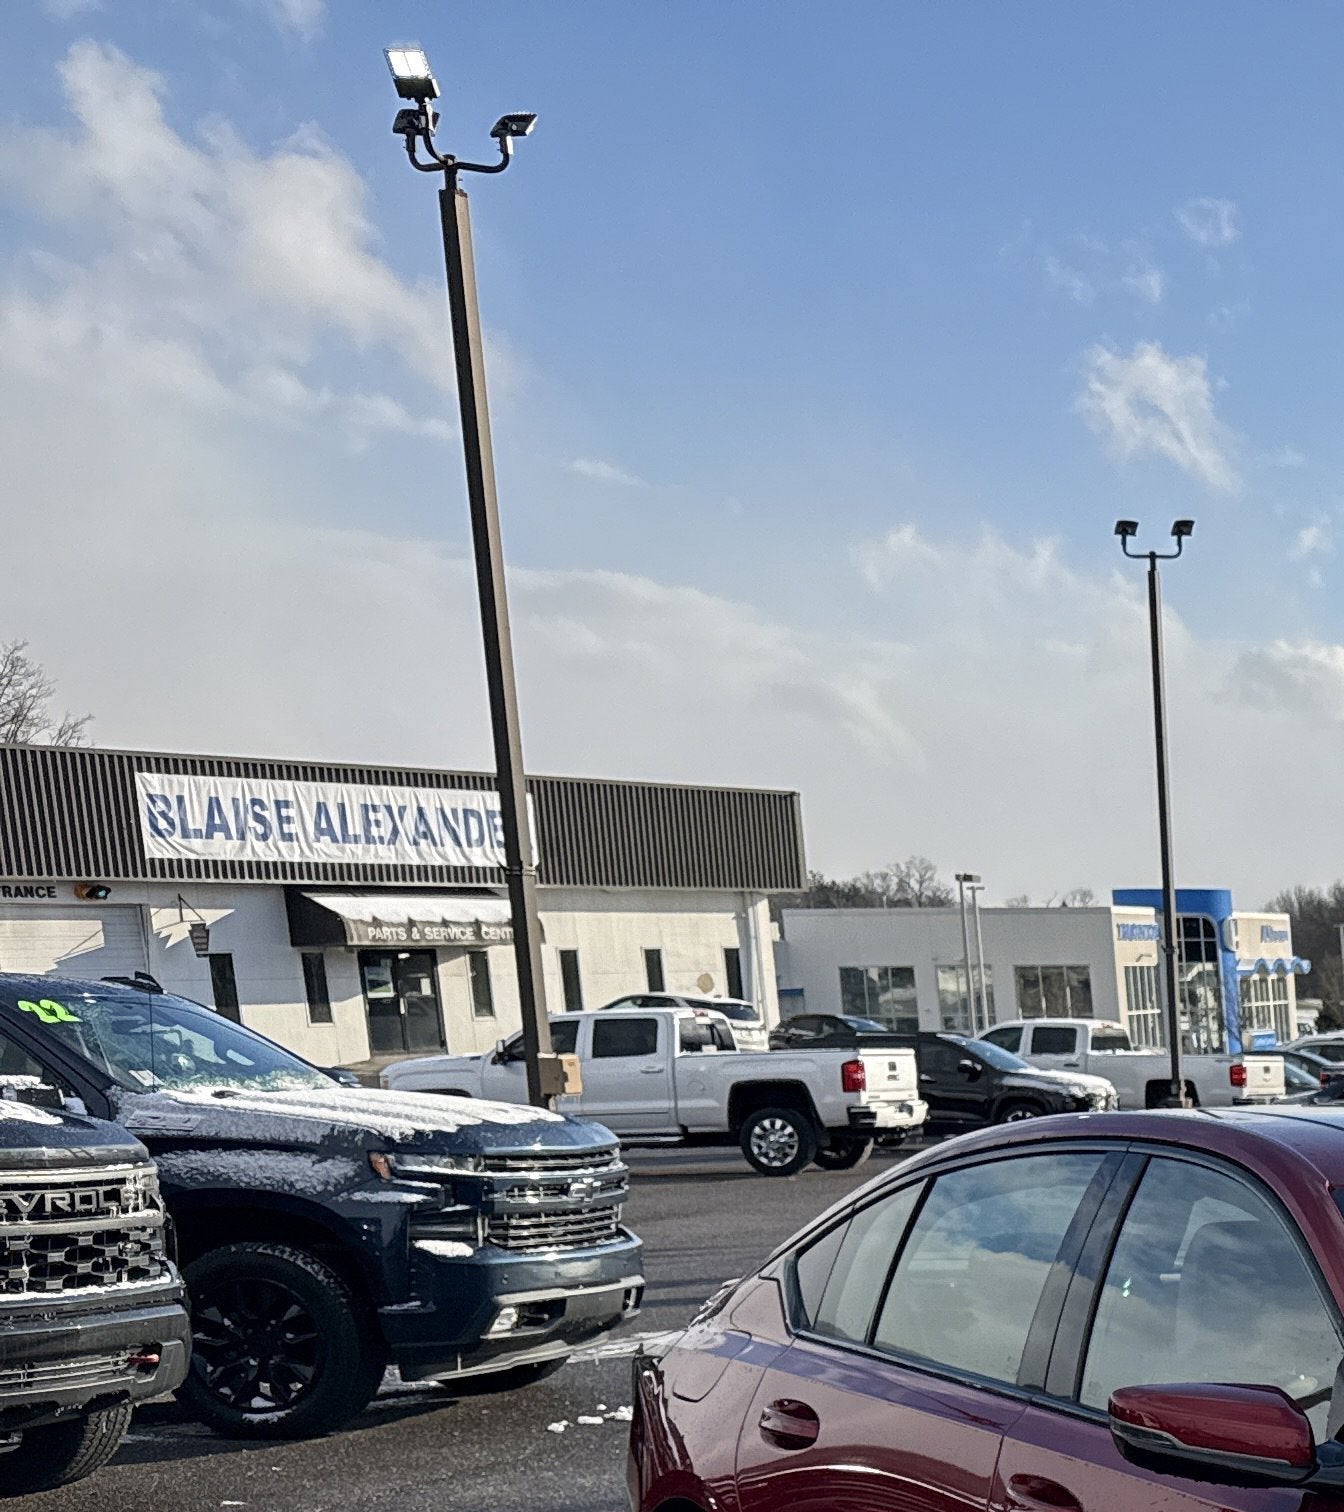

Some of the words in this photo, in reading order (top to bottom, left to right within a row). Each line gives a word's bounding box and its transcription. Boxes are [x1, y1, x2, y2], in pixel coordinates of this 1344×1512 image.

[145, 792, 300, 843] BLAISE
[312, 801, 506, 851] ALEXANDE
[0, 885, 58, 899] RANCE
[367, 926, 408, 941] PARTS
[410, 926, 421, 940] &
[423, 926, 476, 941] SERVICE
[480, 924, 514, 941] CENT
